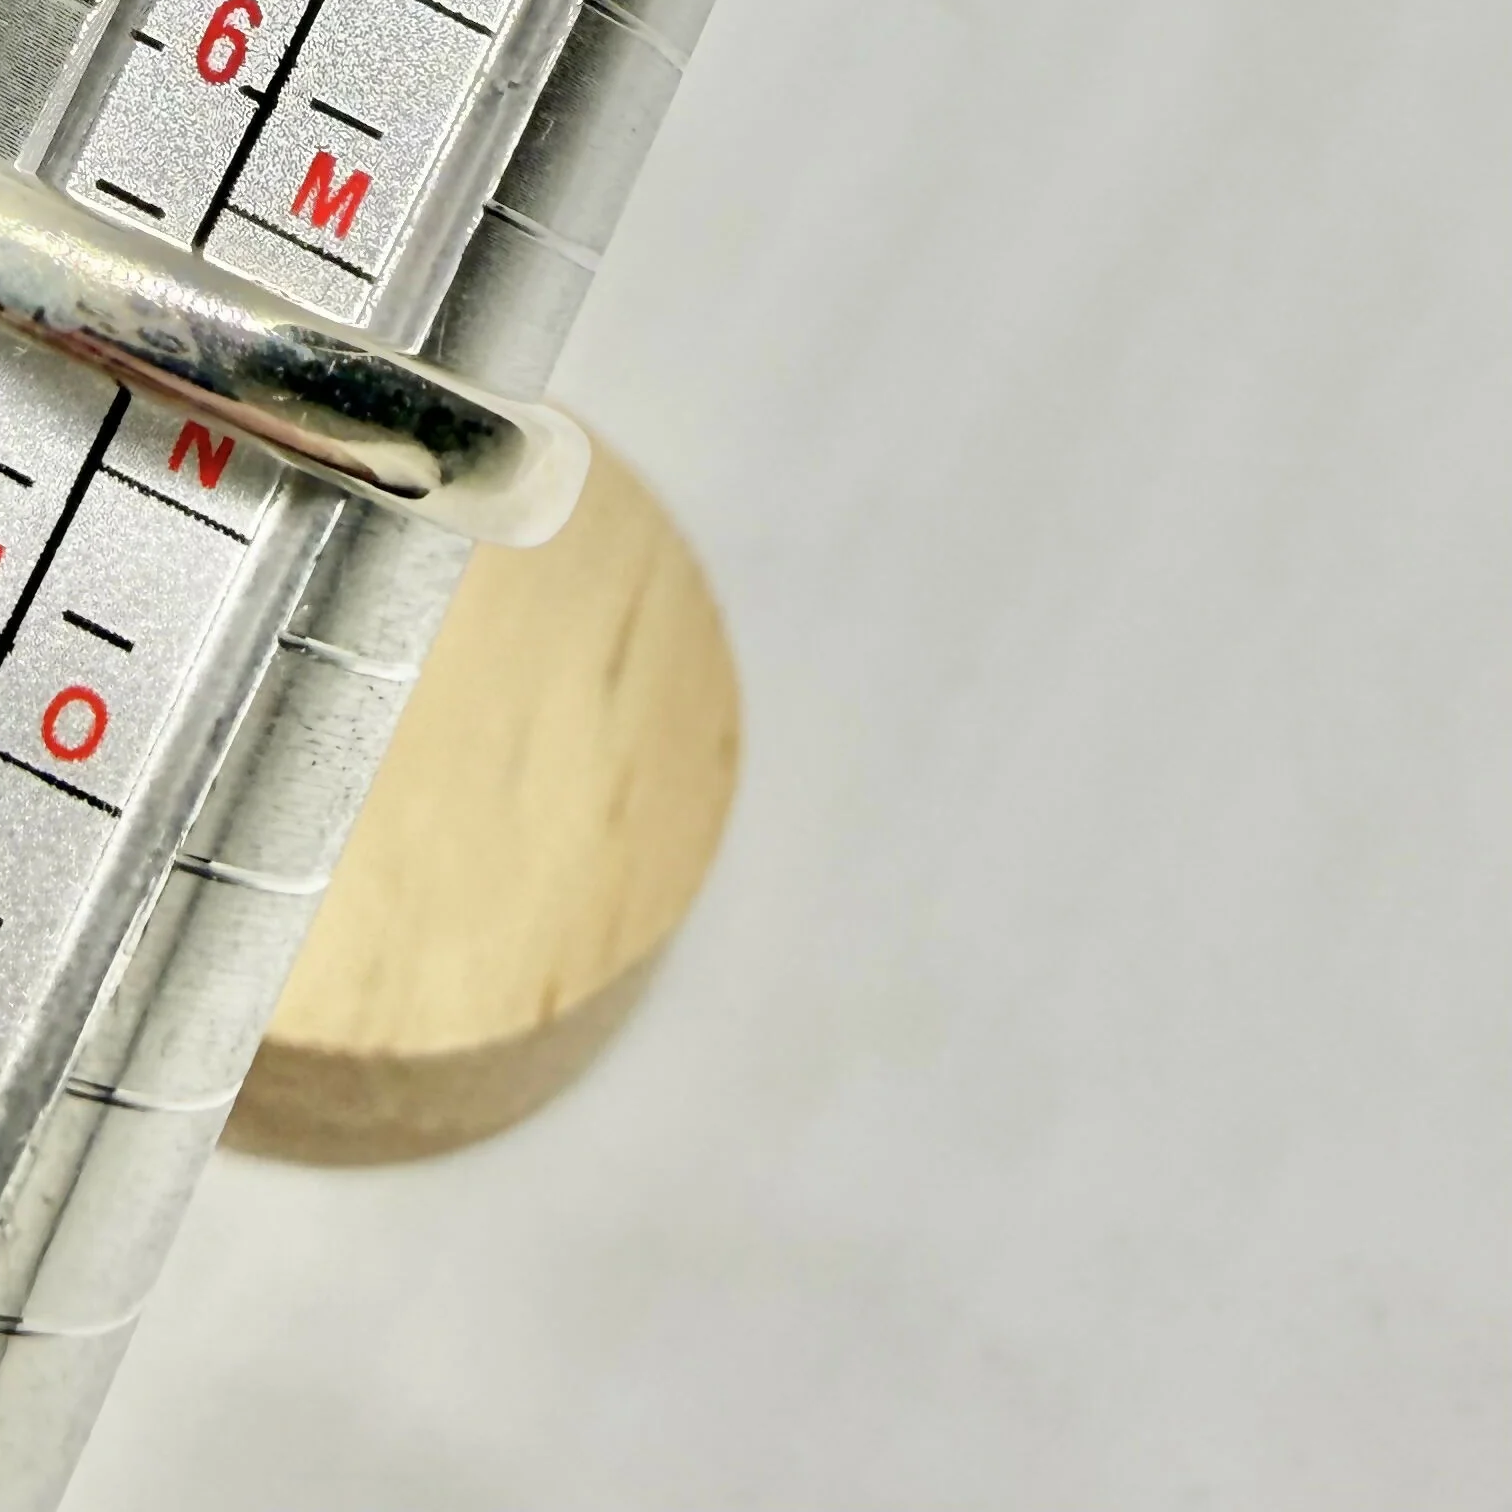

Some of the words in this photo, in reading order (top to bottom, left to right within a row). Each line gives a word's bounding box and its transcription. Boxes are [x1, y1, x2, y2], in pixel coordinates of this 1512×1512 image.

[289, 149, 372, 240] M
[167, 419, 236, 490] N
[40, 685, 110, 764] O
